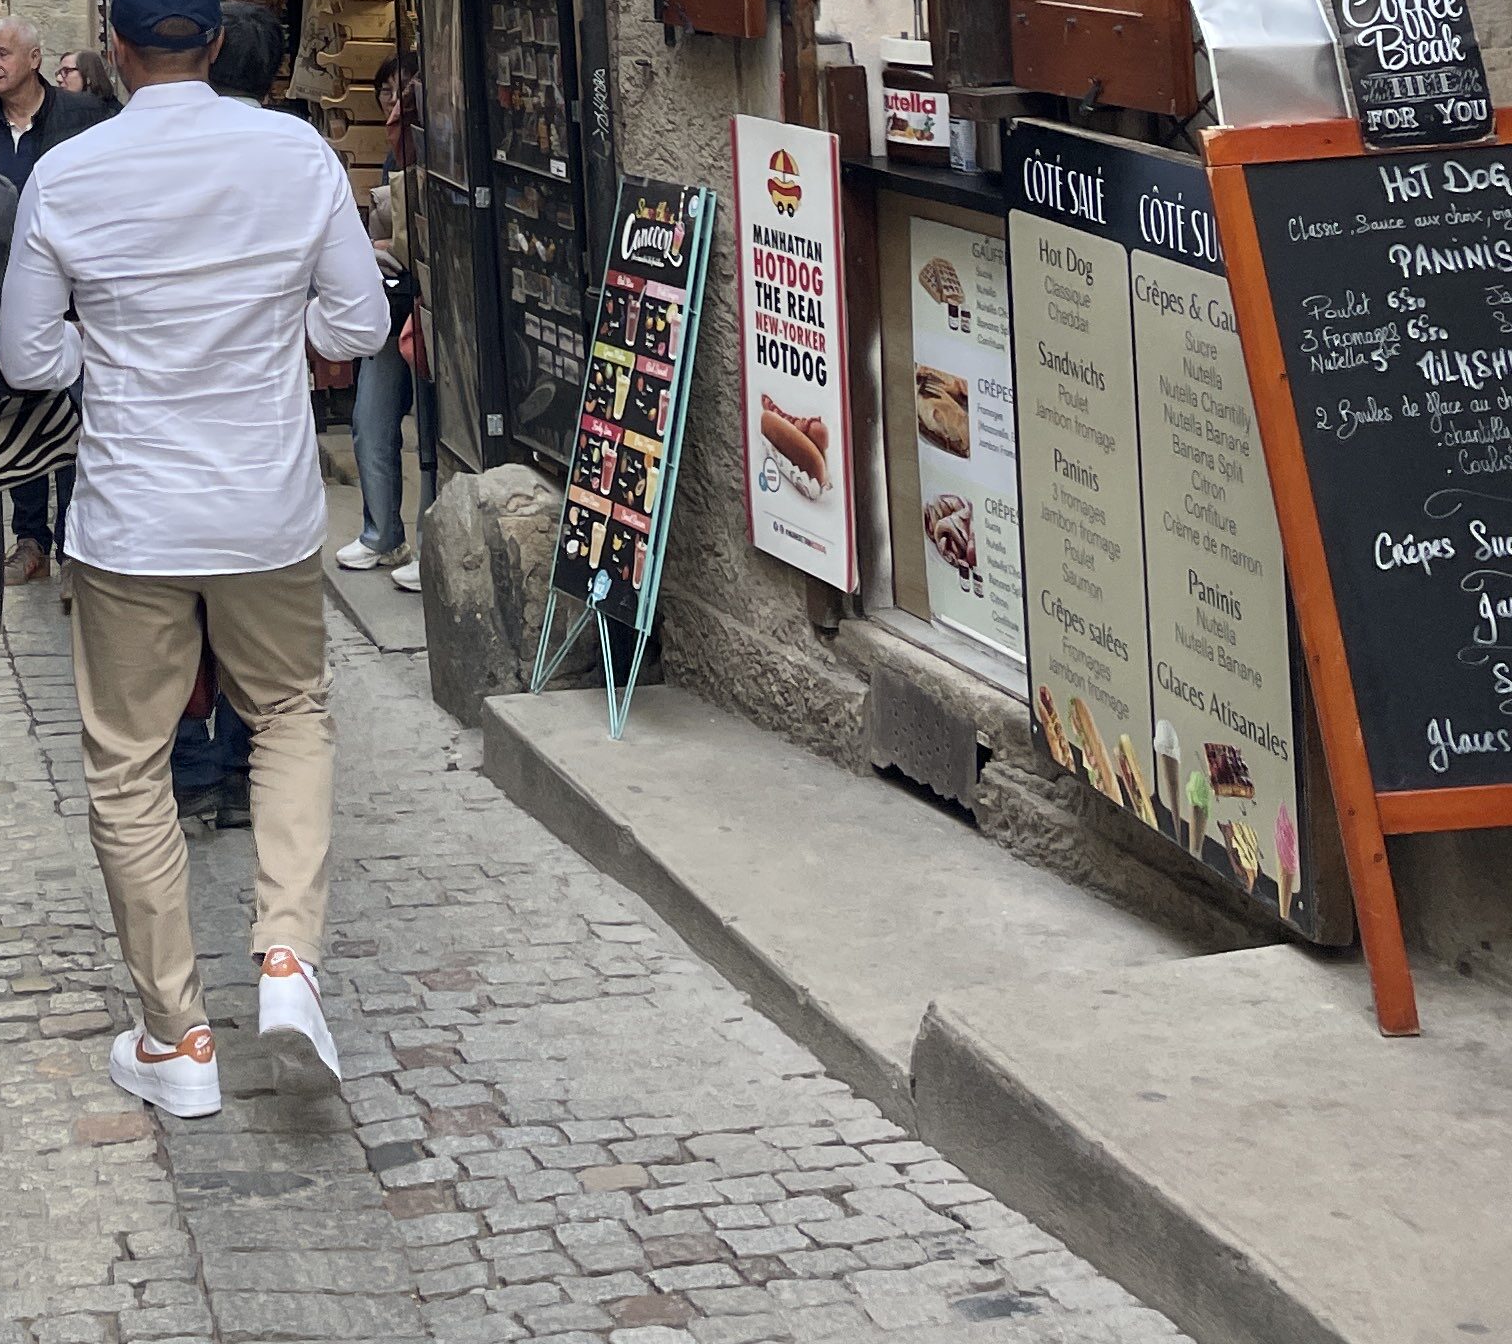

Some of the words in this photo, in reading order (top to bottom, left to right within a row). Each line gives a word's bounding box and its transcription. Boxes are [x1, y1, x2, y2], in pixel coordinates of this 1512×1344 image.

[1357, 23, 1466, 71] Break
[1388, 72, 1458, 100] TIME
[1367, 106, 1419, 132] FOR
[1434, 98, 1487, 125] YOU
[1023, 148, 1065, 212] CÔTÉ
[1068, 166, 1107, 225] SALÉ
[753, 223, 823, 263] MANHATTAN
[1139, 185, 1188, 254] CÔTÉ
[1191, 209, 1225, 263] SU
[753, 246, 824, 297] HOTDOG
[1039, 237, 1062, 269] Hot
[1066, 246, 1094, 286] Dog
[755, 280, 781, 314] THE
[787, 290, 825, 329] REAL
[1135, 274, 1185, 316] Crêpes
[1189, 293, 1203, 322] &
[755, 309, 826, 354] NEW-YORKER
[1185, 330, 1218, 360] Sucre
[1301, 329, 1318, 352] 3
[756, 333, 828, 388] HOTDOG
[1038, 340, 1106, 391] Sandwichs
[1183, 357, 1223, 390] Nutella
[1310, 346, 1369, 374] Nutella
[1159, 374, 1198, 408] Nutella
[1201, 391, 1252, 434] Chantilly
[1315, 405, 1334, 430] 2
[1402, 394, 1421, 418] de
[1470, 398, 1492, 413] au
[1163, 403, 1203, 438] Nutella
[1205, 419, 1250, 457] Banane
[1054, 447, 1100, 493] Paninis
[1191, 469, 1226, 502] Citron
[1218, 453, 1244, 484] Split
[1183, 493, 1237, 536] Confiture
[1202, 529, 1218, 555] de
[1220, 542, 1263, 577] marron
[1374, 531, 1456, 577] Crêpes
[1188, 568, 1242, 621] Paninis
[1041, 589, 1086, 636] Crêpes
[1089, 622, 1129, 662] salées
[1174, 621, 1215, 662] Nutella
[1196, 606, 1236, 646] Nutella
[1157, 661, 1205, 712] Glaces
